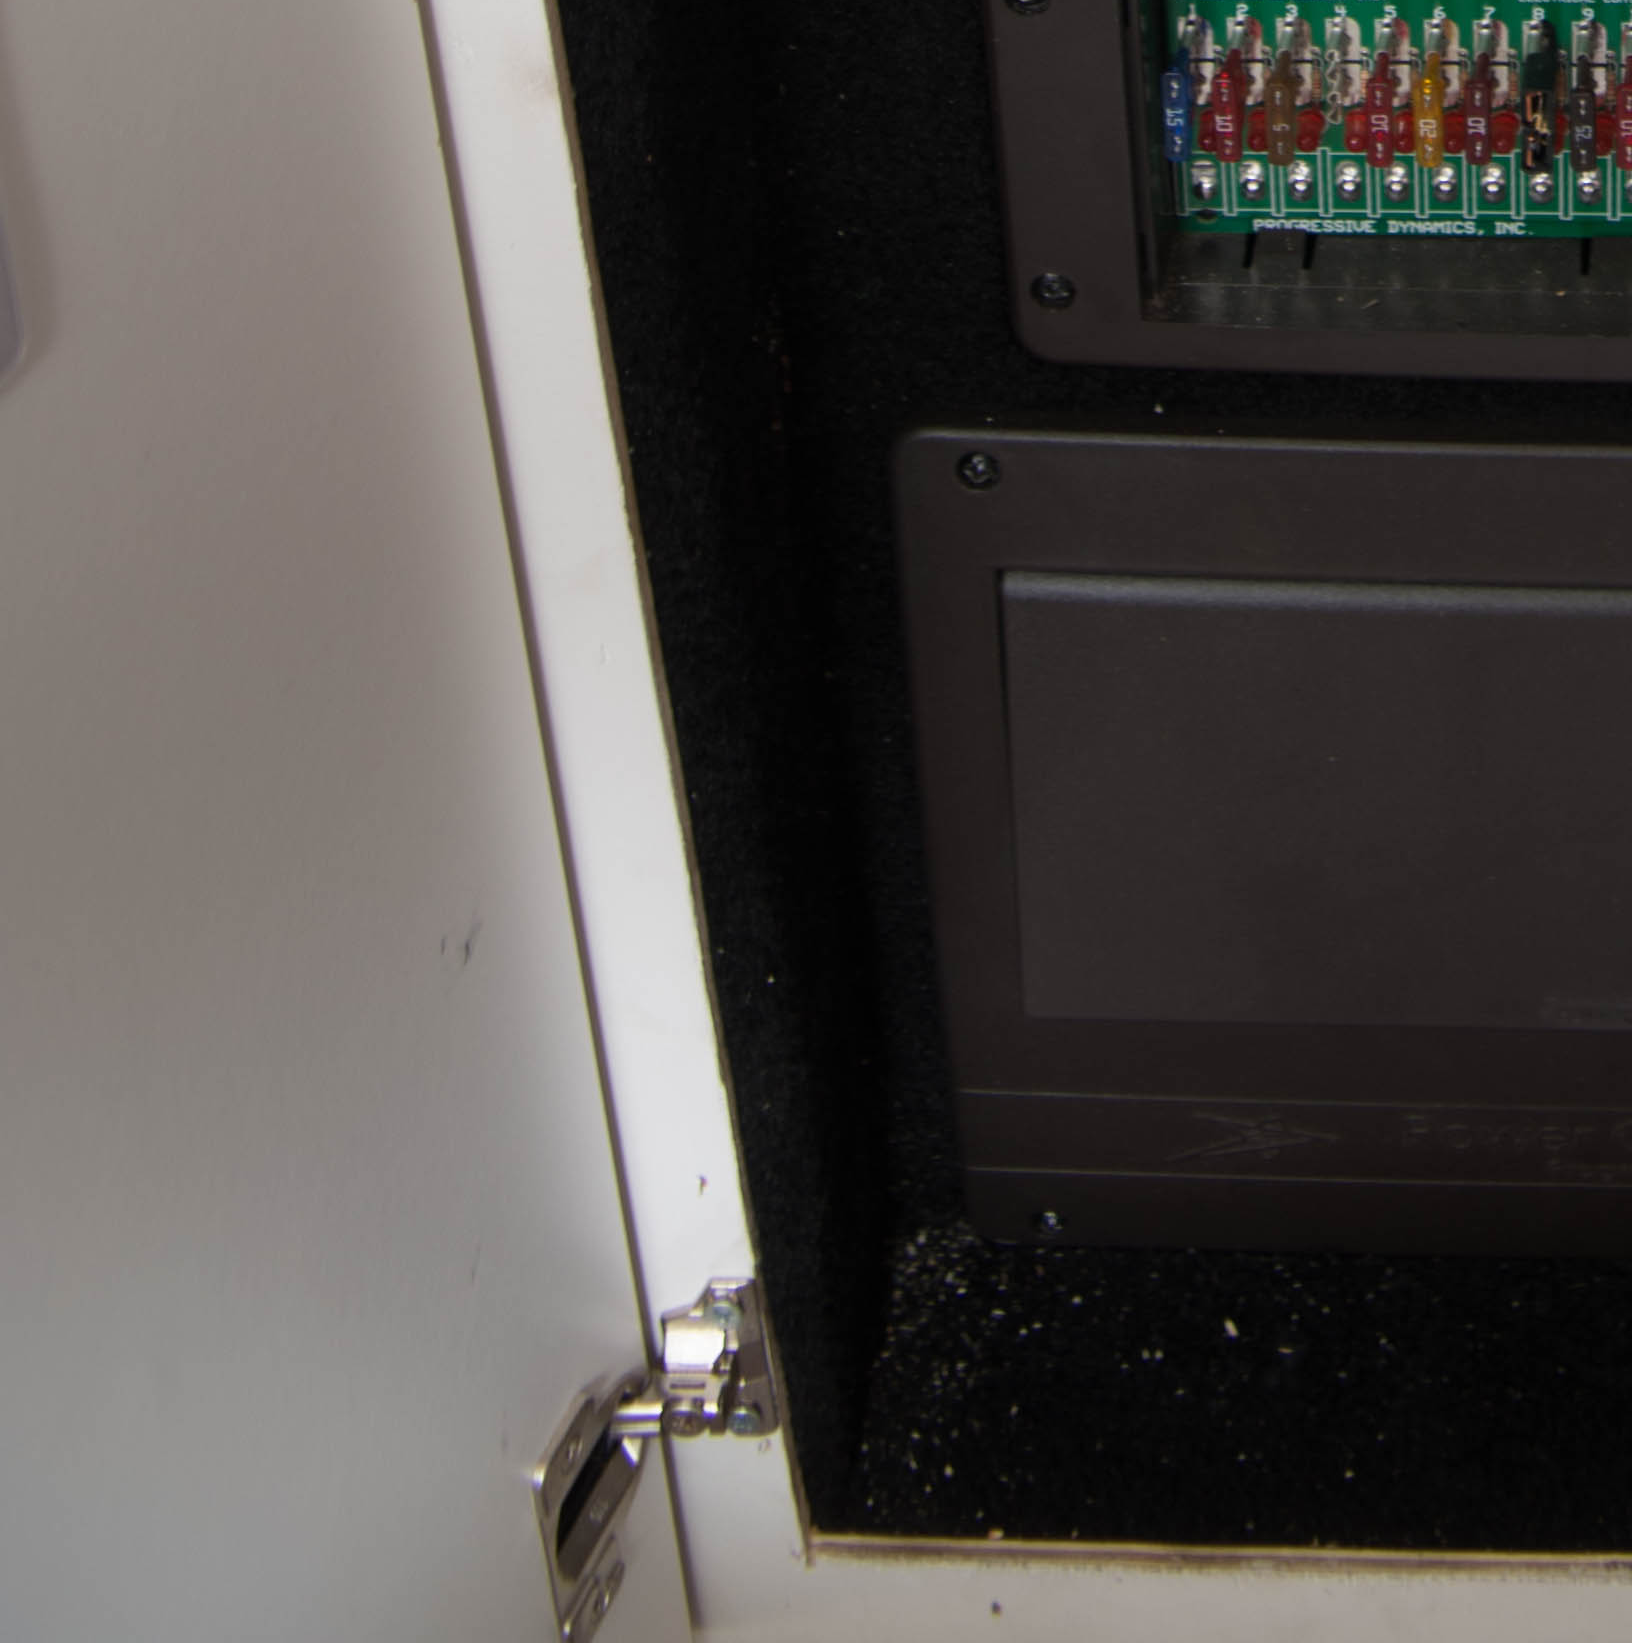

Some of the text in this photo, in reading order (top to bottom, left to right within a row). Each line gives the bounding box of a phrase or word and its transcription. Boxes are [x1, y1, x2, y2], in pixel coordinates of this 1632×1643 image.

[1235, 3, 1249, 18] 2
[1285, 4, 1299, 19] 3
[1333, 4, 1348, 18] 4
[1383, 5, 1398, 19] 5
[1433, 6, 1447, 20] 6
[1482, 6, 1497, 21] 7
[1531, 7, 1545, 21] 8
[1581, 7, 1595, 22] 9
[1165, 107, 1185, 127] 15
[1215, 115, 1233, 132] 10
[1371, 114, 1390, 133] 10
[1467, 117, 1486, 134] 10
[1418, 118, 1438, 138] 20
[1253, 218, 1535, 236] PROGRESSIVE DYNAMICS, INC.
